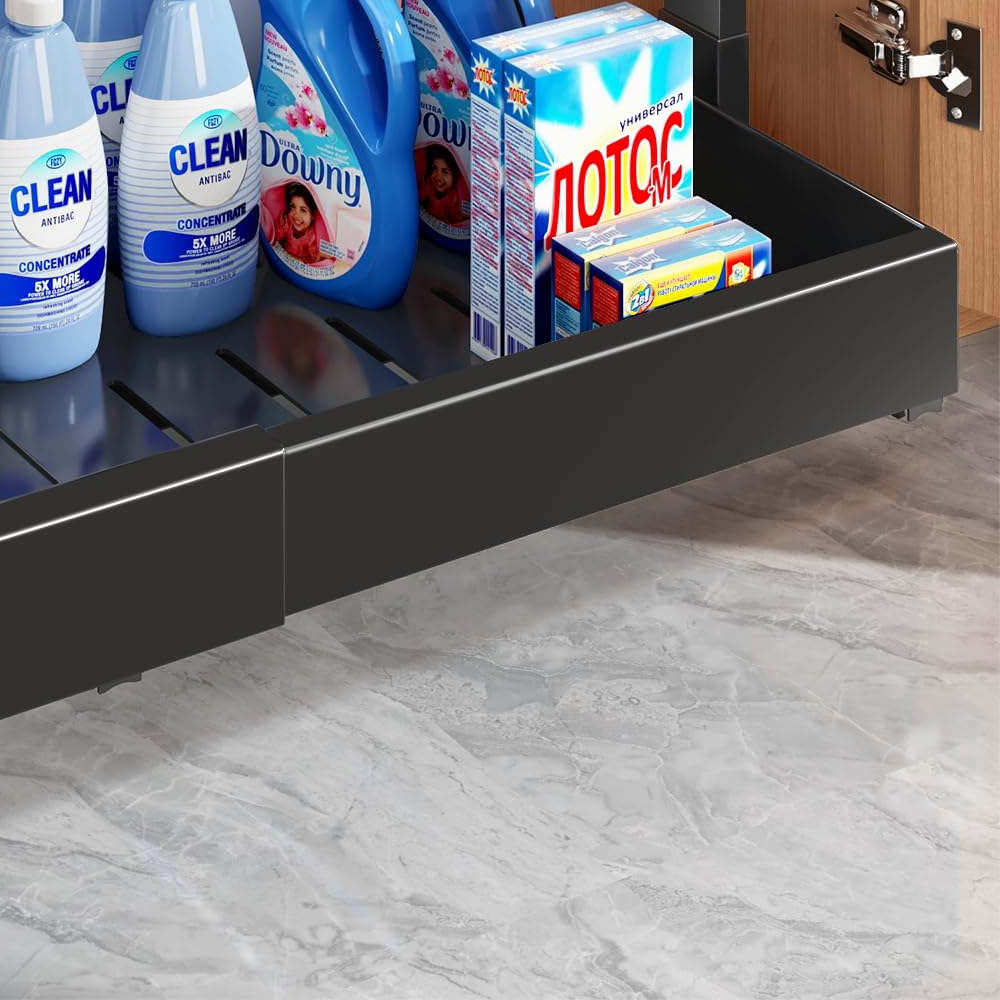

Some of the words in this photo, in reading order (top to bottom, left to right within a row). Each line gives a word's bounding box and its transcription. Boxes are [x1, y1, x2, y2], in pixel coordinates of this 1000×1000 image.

[619, 92, 683, 132] универсал
[169, 127, 248, 176] CLEAN
[278, 138, 300, 151] ULTRA
[199, 170, 231, 186] ANTIBAC
[259, 129, 361, 207] Downy
[10, 167, 92, 217] CLEAN
[41, 211, 75, 227] ANTIBAC
[177, 202, 247, 230] CONCENTRATE
[192, 237, 207, 249] 5X
[210, 228, 237, 246] MORE
[19, 243, 91, 273] CONCENTRATE
[34, 280, 49, 293] 5X
[52, 270, 81, 290] MORE
